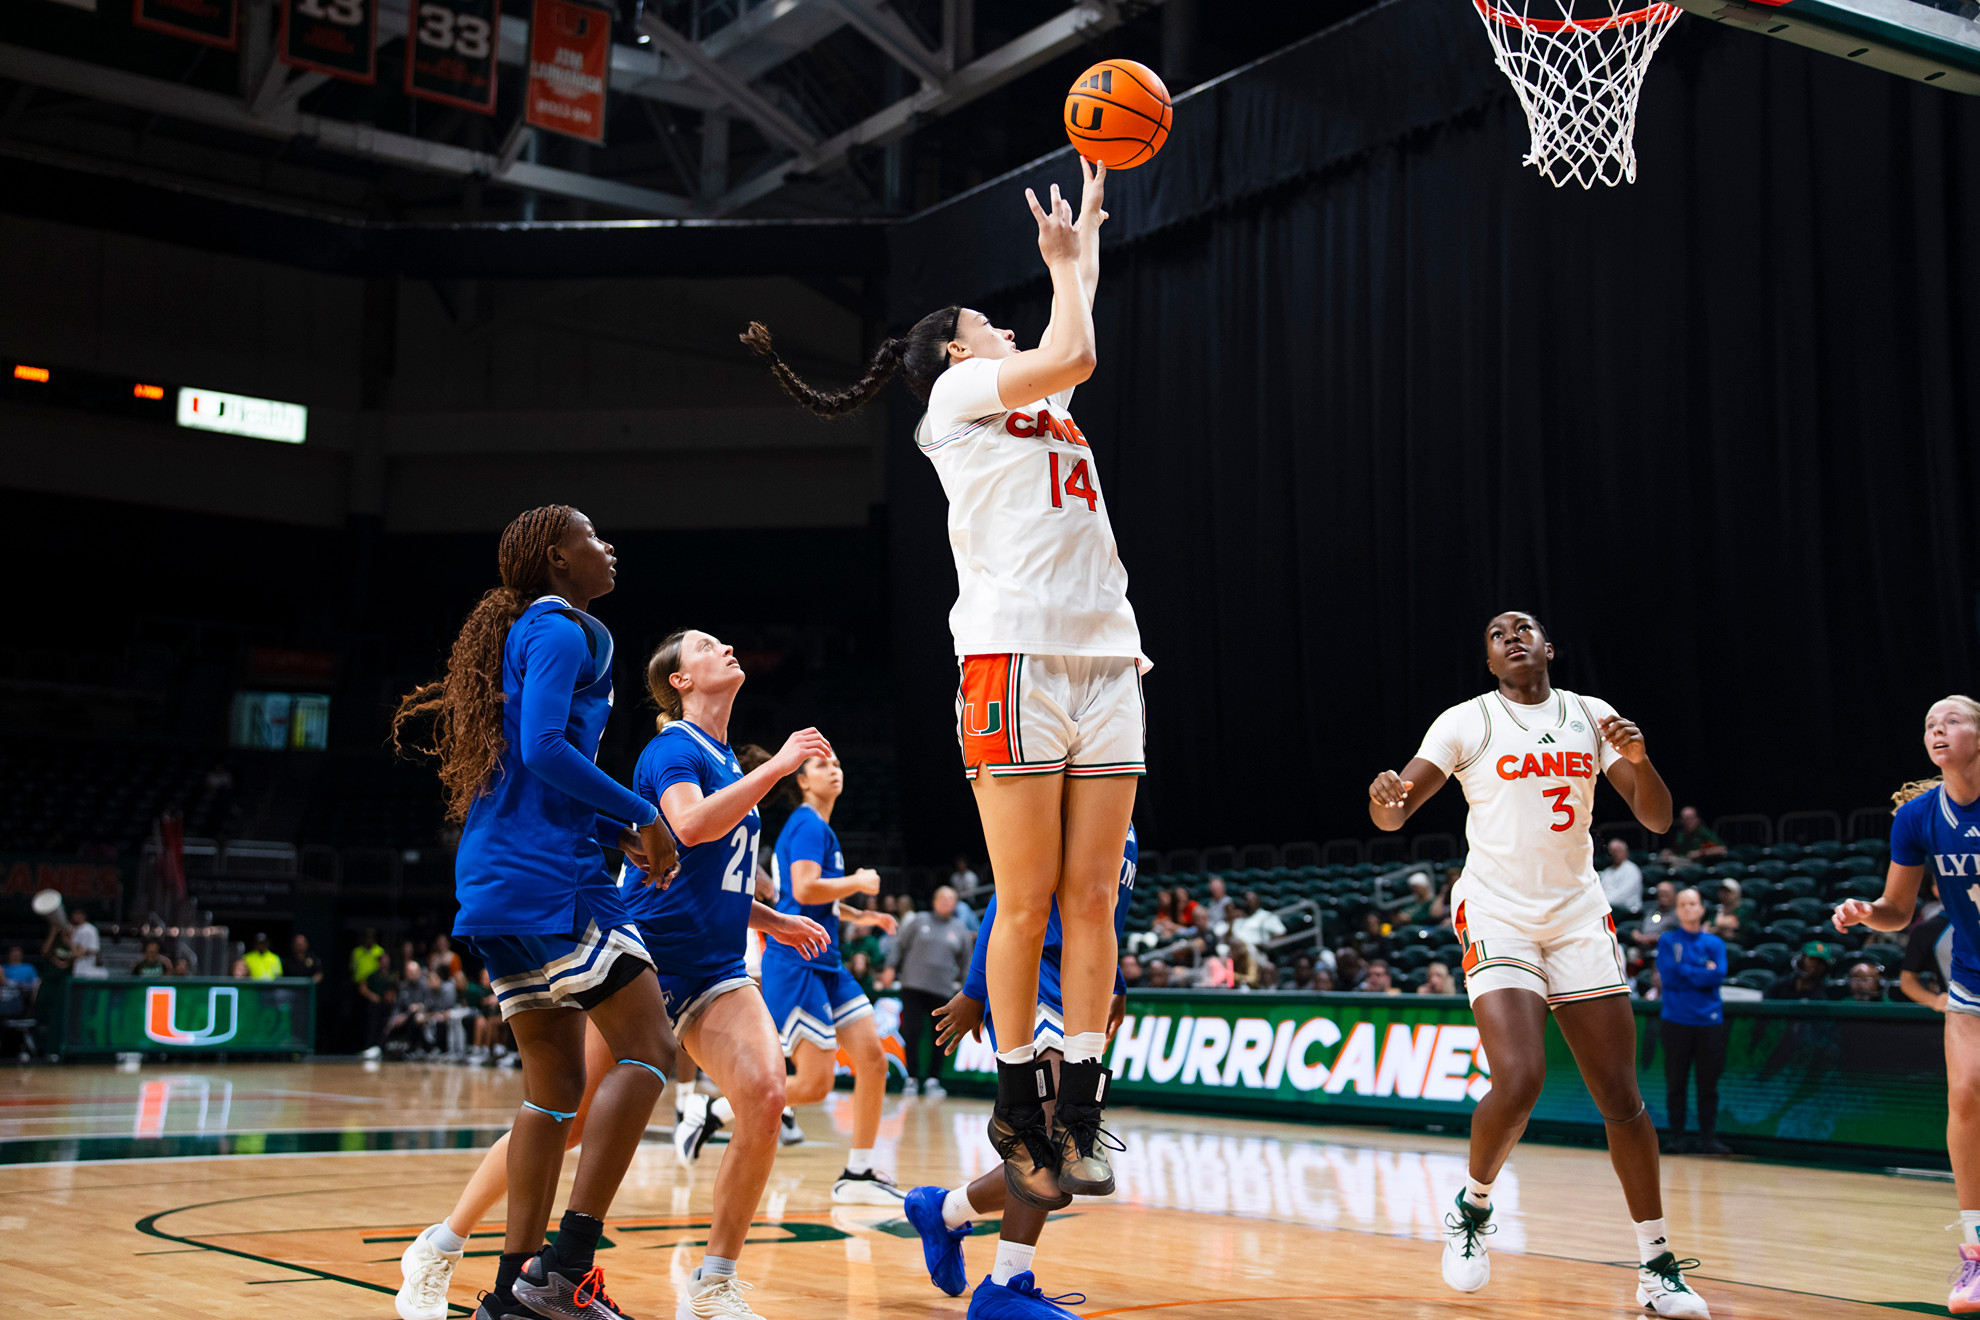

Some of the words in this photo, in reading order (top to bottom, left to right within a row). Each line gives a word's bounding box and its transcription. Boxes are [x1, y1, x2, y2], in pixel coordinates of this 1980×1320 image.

[418, 2, 491, 59] 33
[1071, 102, 1104, 131] U
[1048, 452, 1097, 512] 14
[964, 701, 1002, 736] U
[1496, 751, 1593, 780] CANES
[1542, 786, 1575, 832] 3
[721, 825, 760, 895] 21
[144, 986, 238, 1046] U
